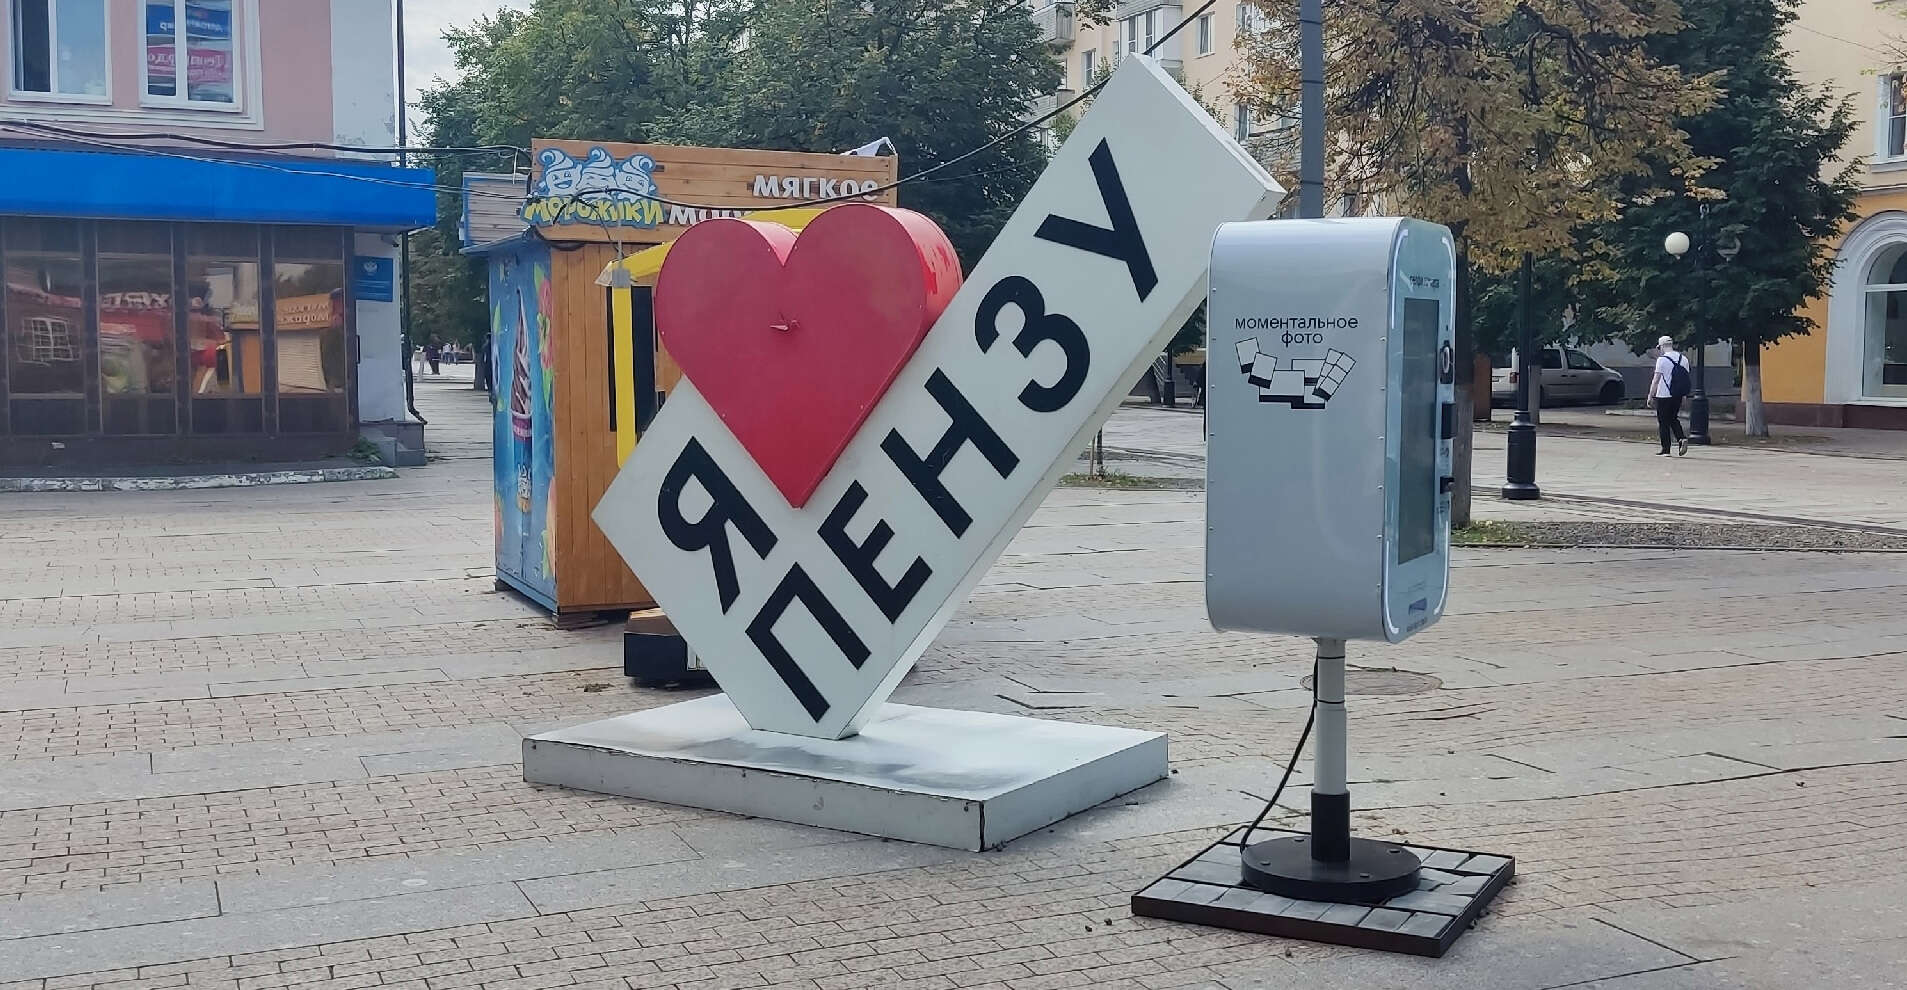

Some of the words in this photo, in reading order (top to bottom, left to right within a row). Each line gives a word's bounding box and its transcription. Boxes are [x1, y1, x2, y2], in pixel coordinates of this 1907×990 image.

[524, 195, 665, 225] МОРОЖИКИ
[1235, 317, 1359, 329] моментальное
[1281, 330, 1324, 348] фото
[745, 138, 1158, 723] ПЕНЗУ
[658, 436, 778, 615] Я
